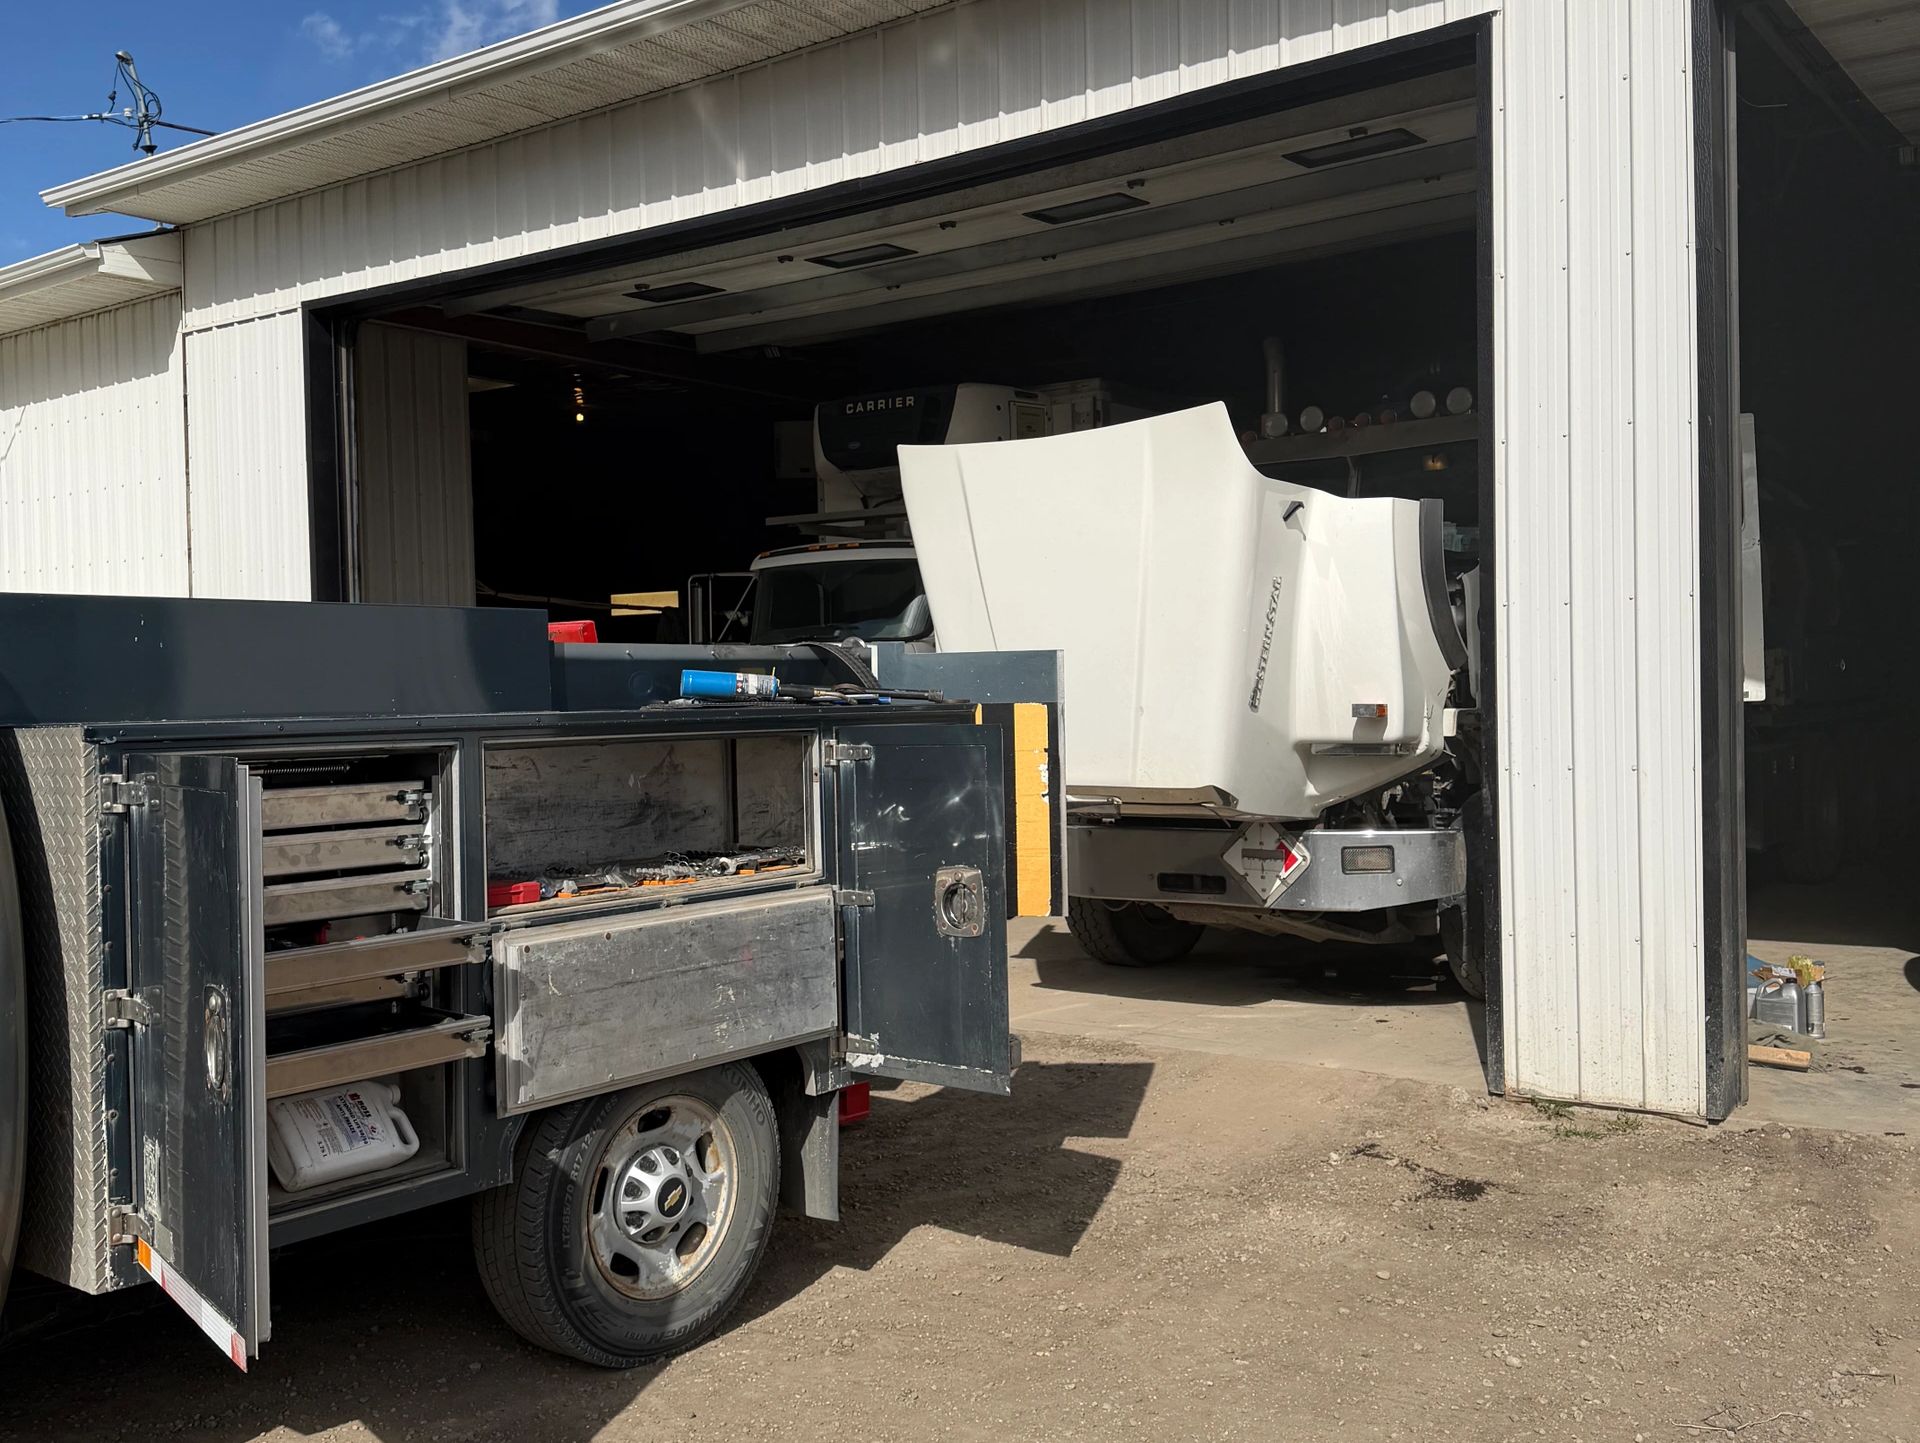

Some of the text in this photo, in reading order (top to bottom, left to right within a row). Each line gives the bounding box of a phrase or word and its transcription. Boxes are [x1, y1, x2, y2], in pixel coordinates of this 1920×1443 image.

[846, 396, 915, 415] CARRIER
[720, 1065, 766, 1127] KUMHO
[357, 1100, 372, 1118] BOSS
[569, 1153, 584, 1182] R17
